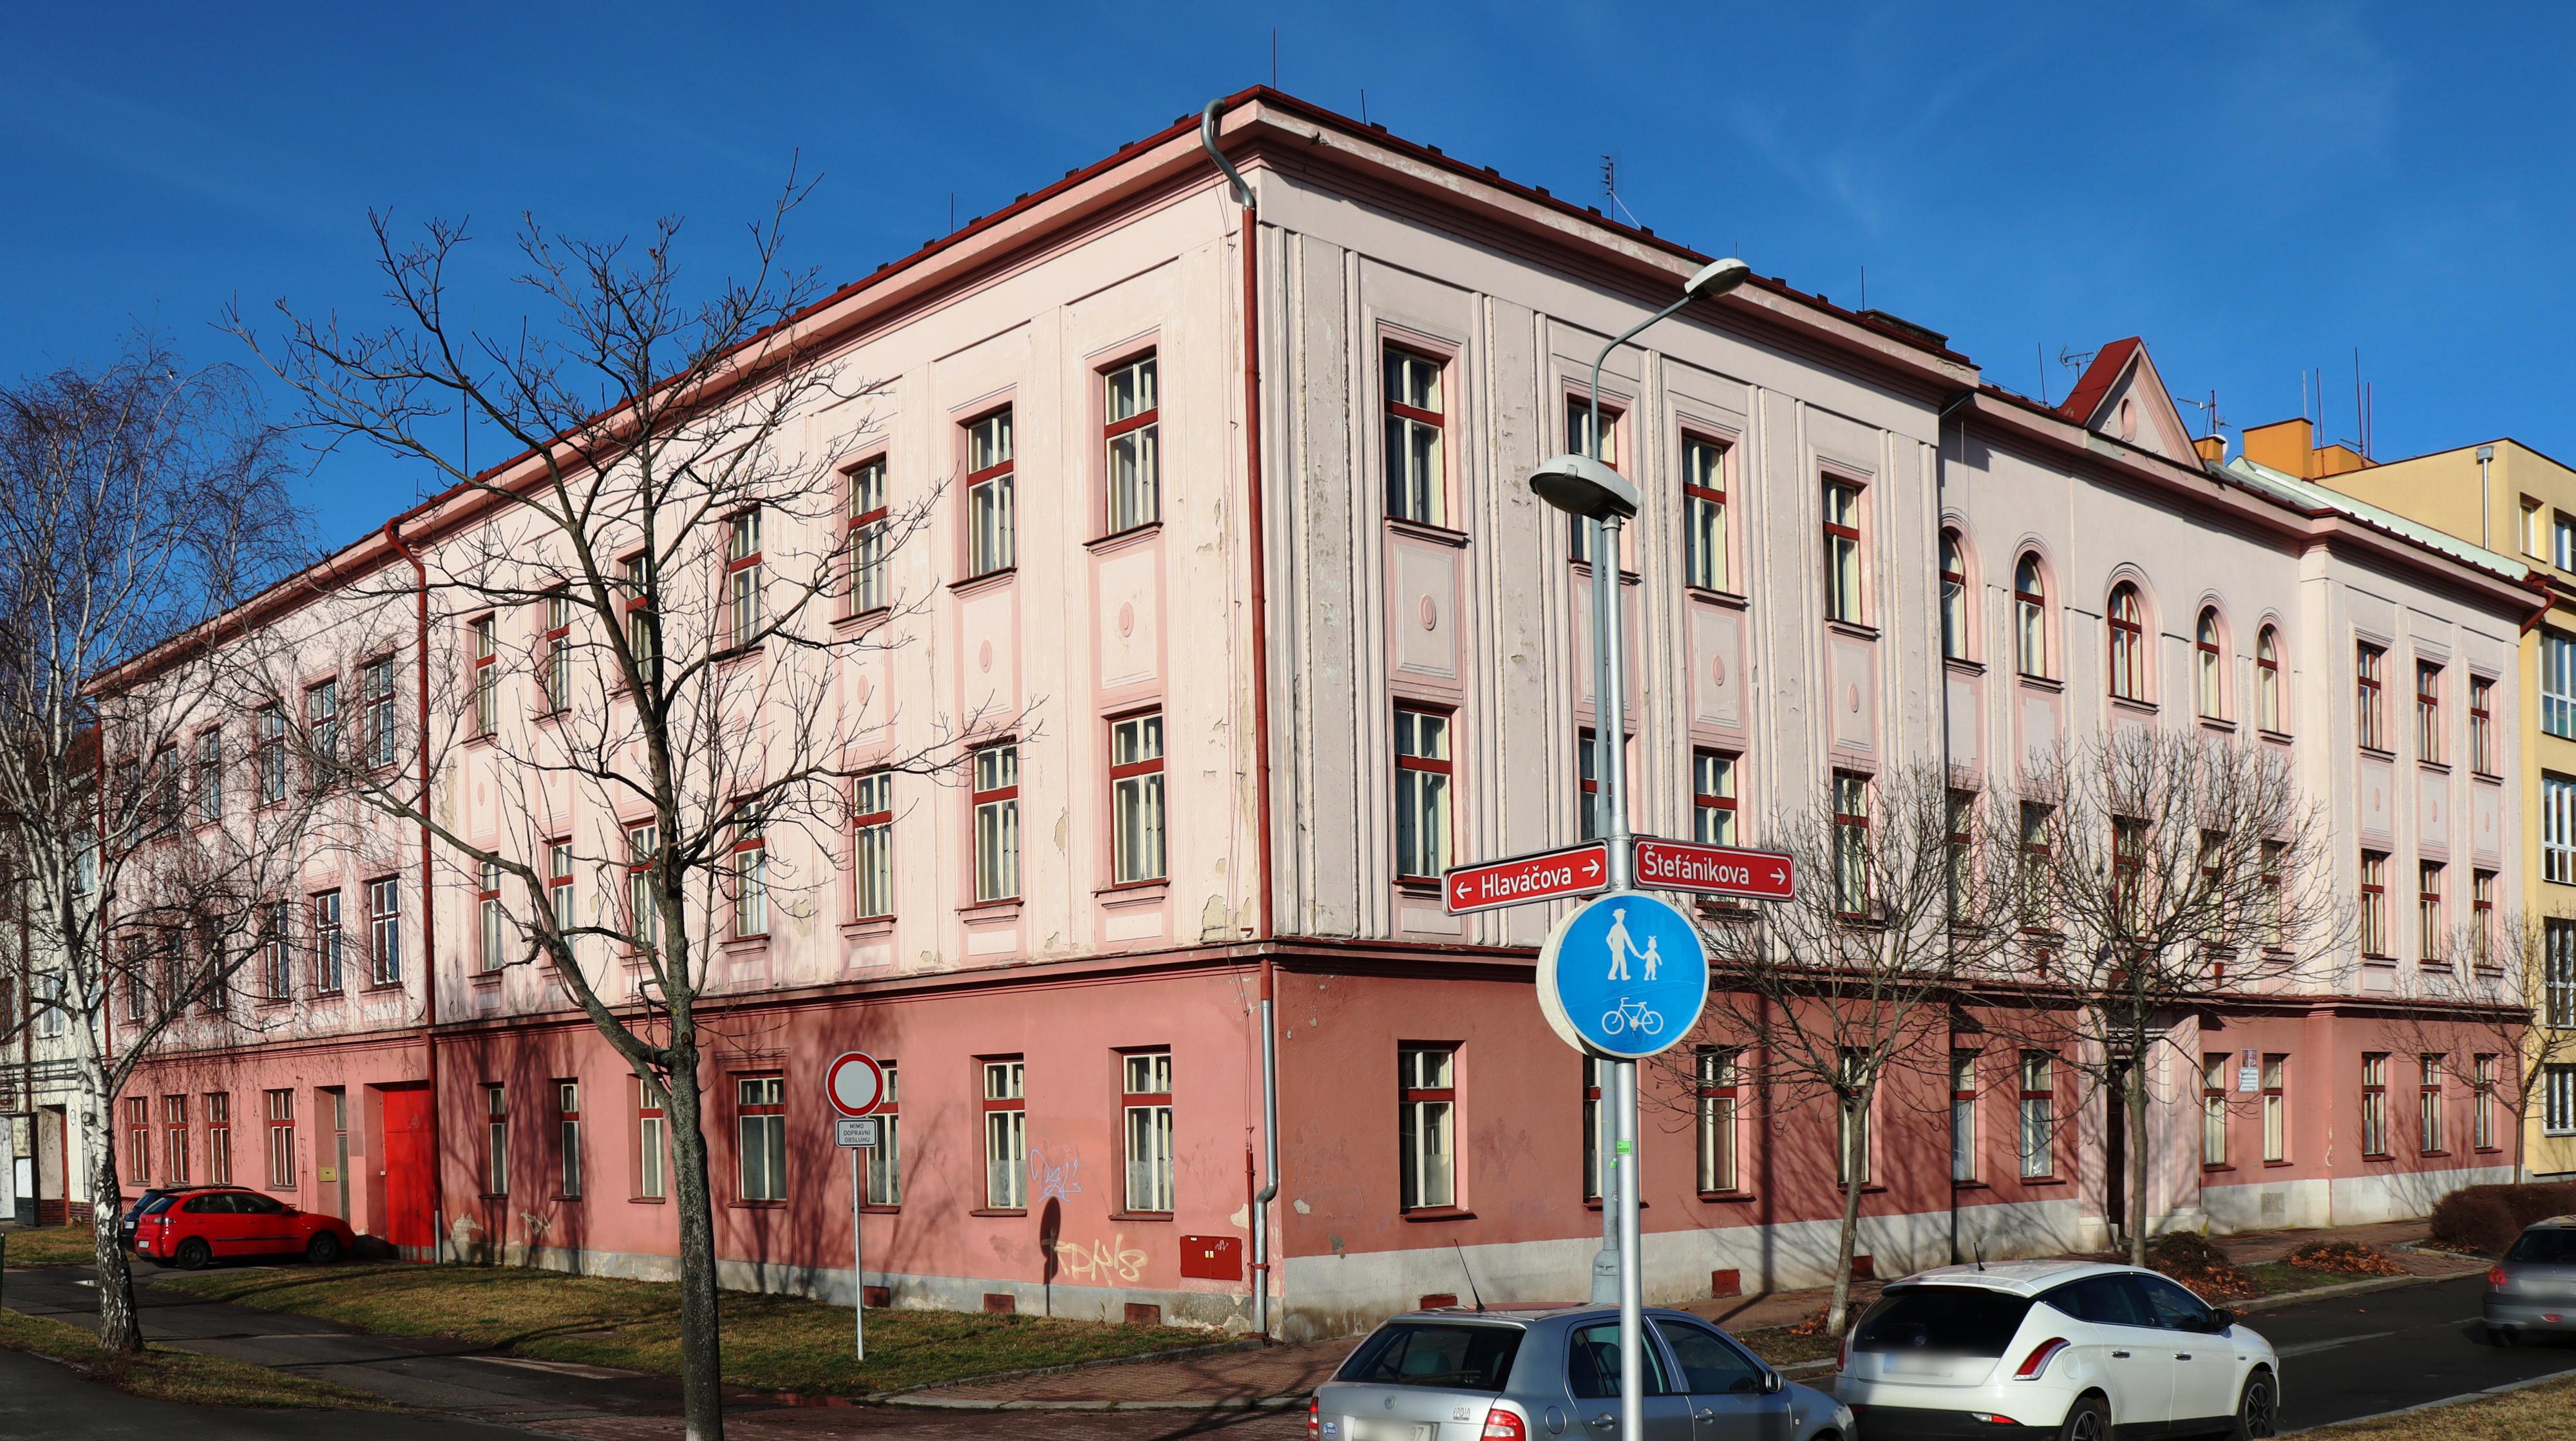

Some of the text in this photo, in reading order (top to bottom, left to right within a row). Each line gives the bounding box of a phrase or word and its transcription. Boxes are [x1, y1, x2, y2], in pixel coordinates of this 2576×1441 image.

[1481, 864, 1572, 899] Hlaváčova
[1644, 844, 1750, 885] Štefánikova
[1453, 1406, 1471, 1417] FABIA
